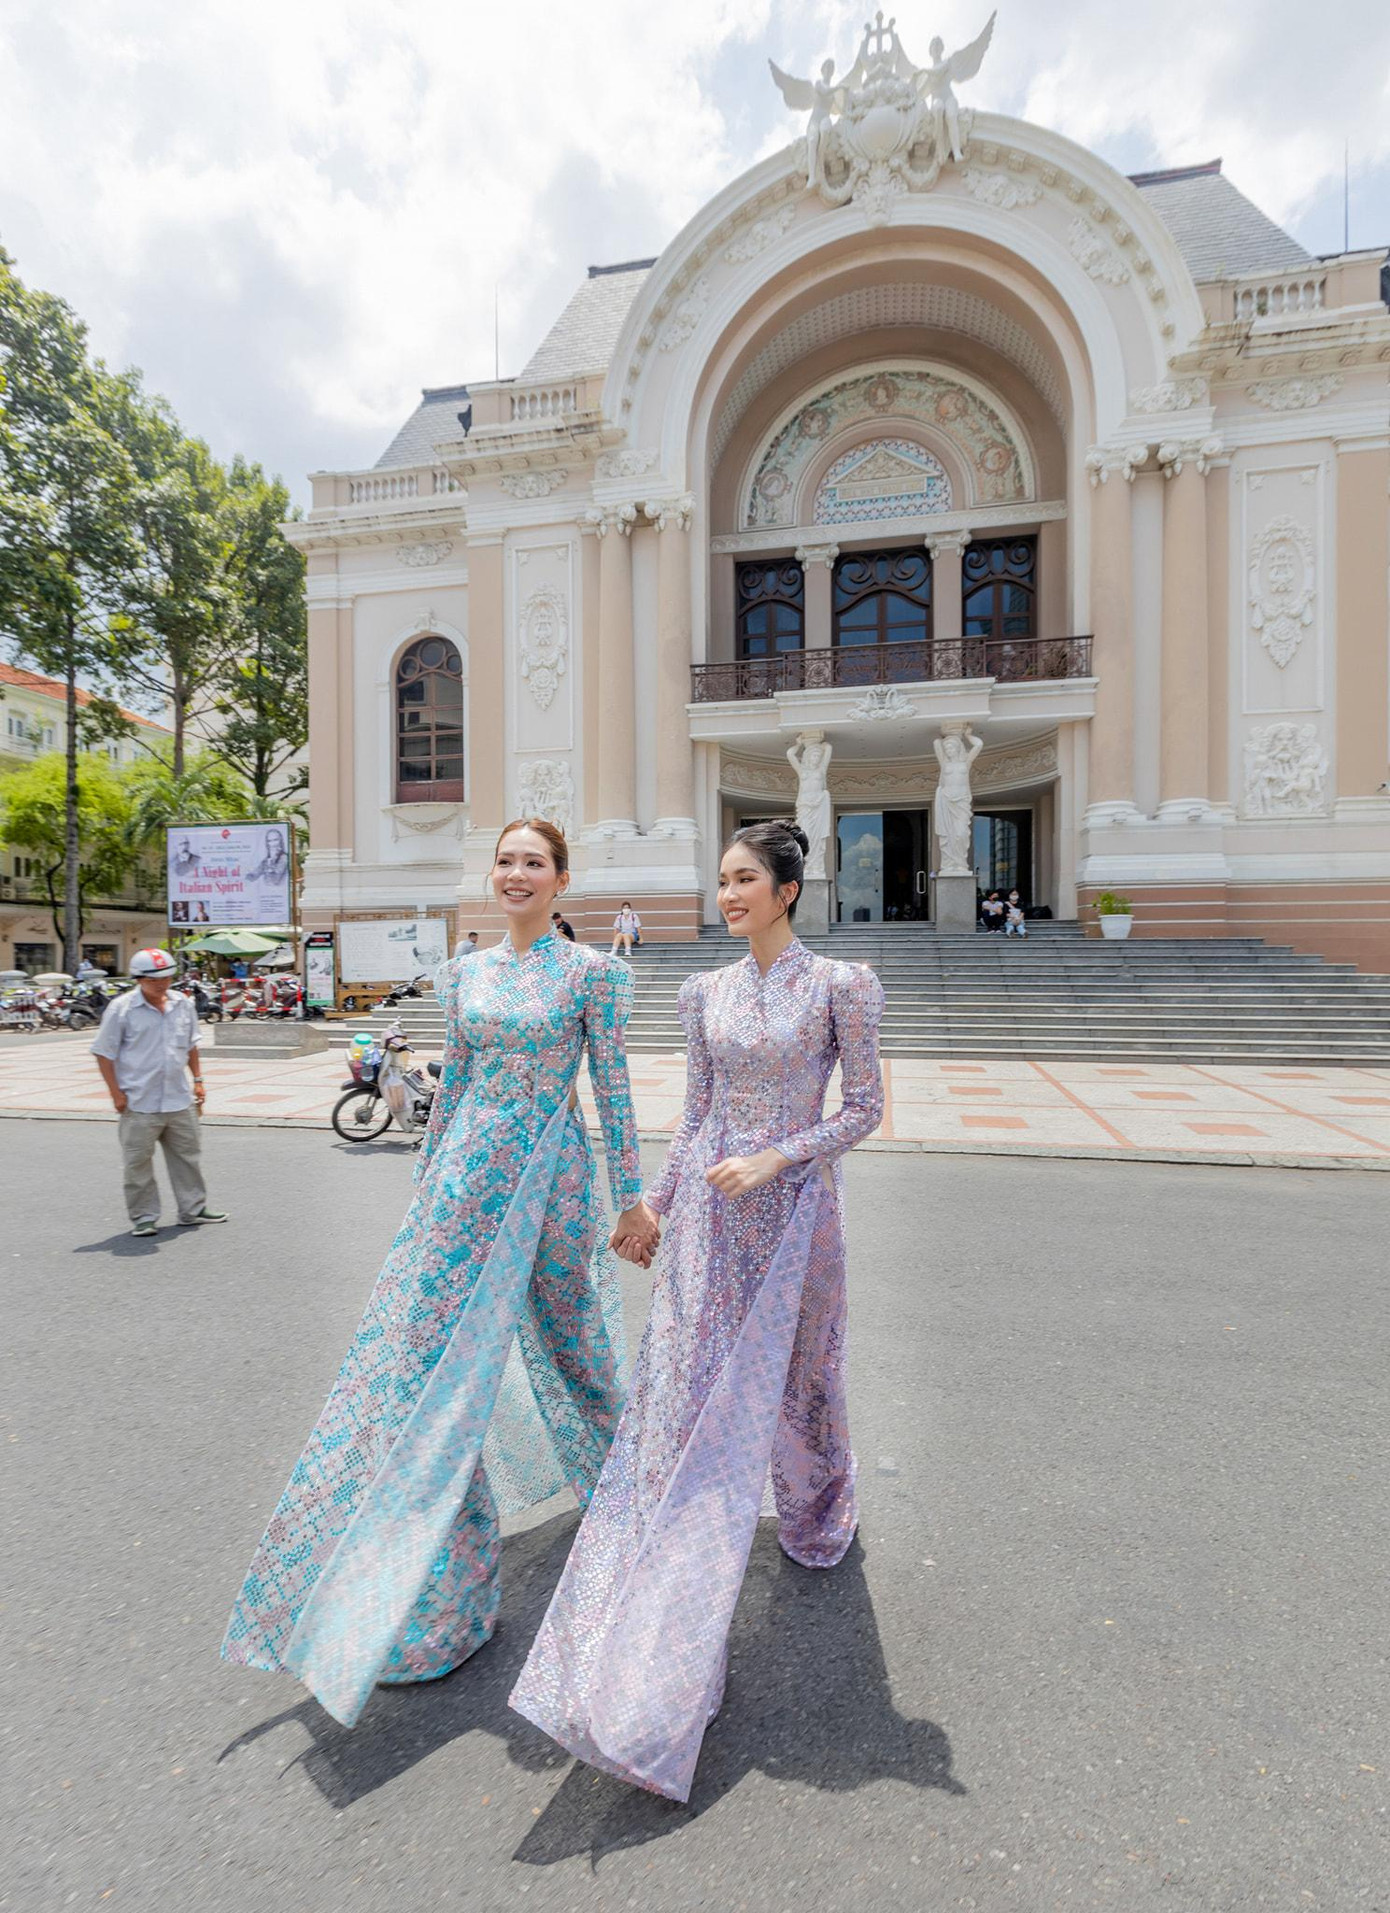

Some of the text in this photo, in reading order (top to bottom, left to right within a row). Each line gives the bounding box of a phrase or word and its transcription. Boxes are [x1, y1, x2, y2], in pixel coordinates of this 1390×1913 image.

[202, 866, 227, 878] Night
[179, 881, 244, 895] Italian Spirit
